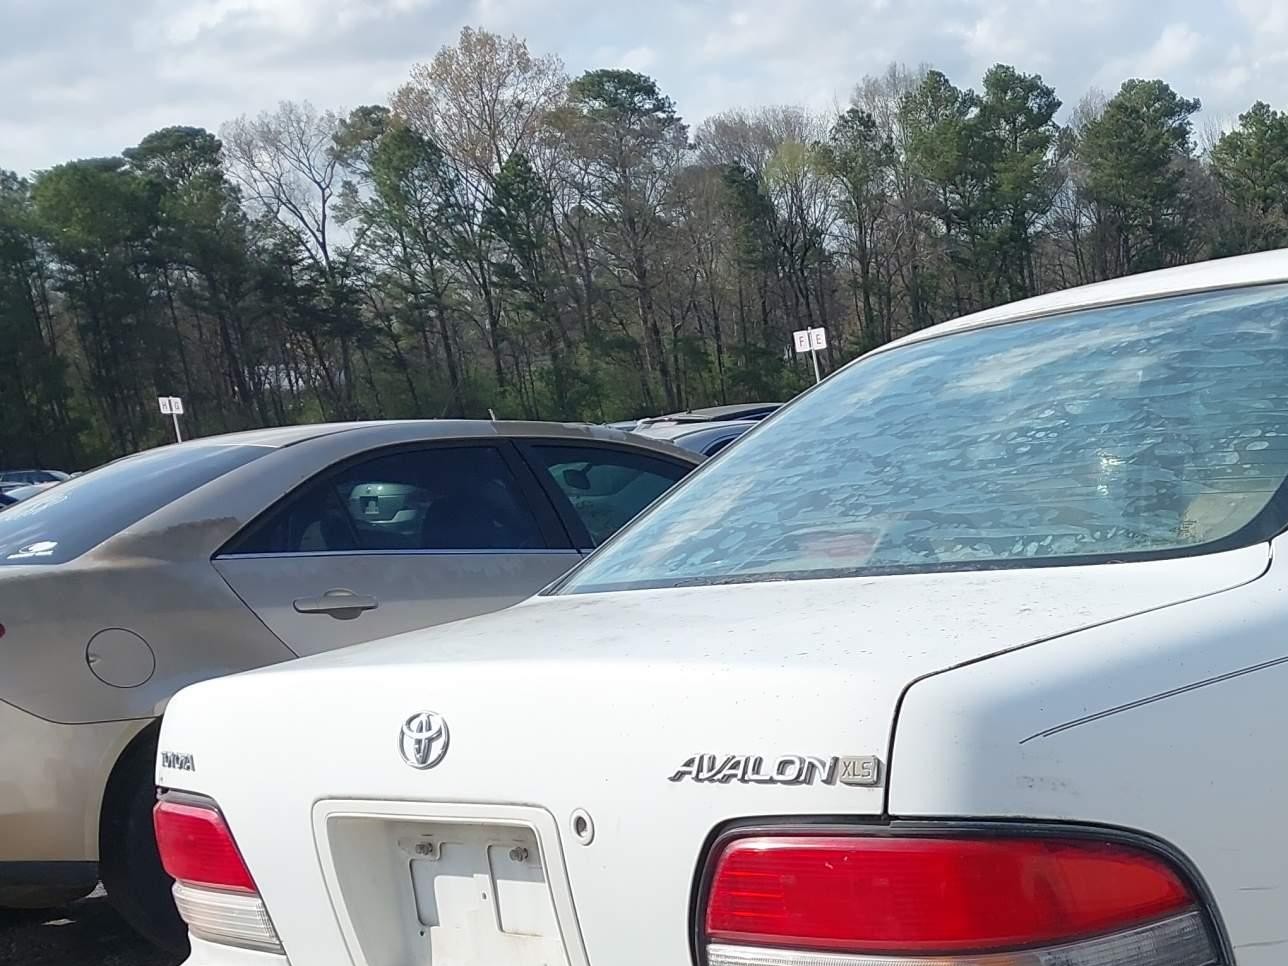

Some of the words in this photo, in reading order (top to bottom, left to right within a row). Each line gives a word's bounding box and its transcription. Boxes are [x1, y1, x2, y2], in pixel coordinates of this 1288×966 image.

[799, 336, 804, 347] F
[815, 334, 822, 345] E
[667, 754, 840, 785] AVALON
[841, 760, 872, 778] XLS
